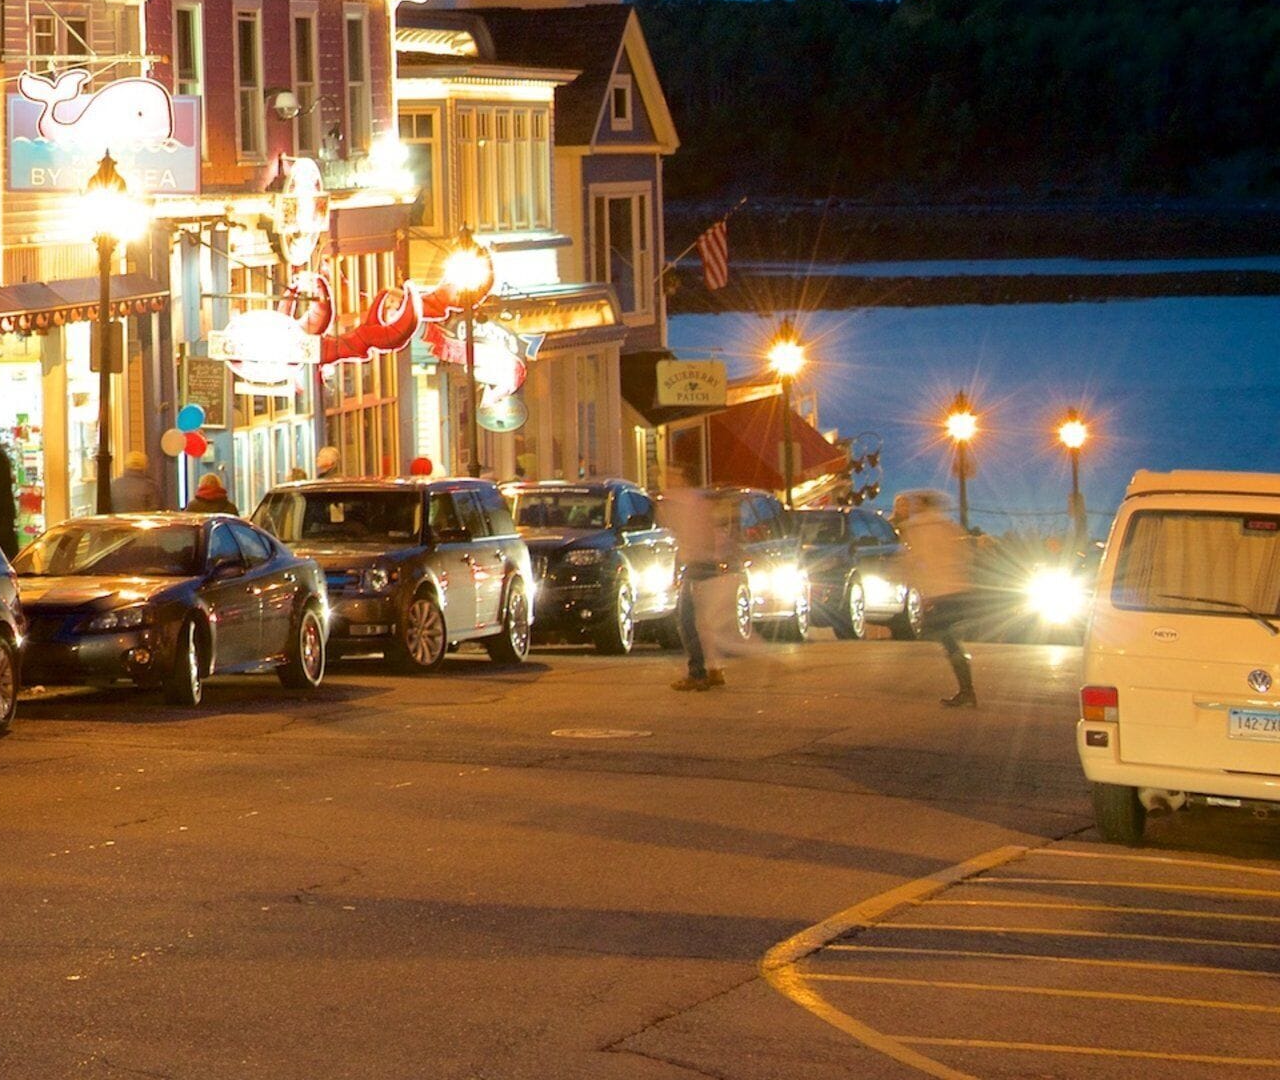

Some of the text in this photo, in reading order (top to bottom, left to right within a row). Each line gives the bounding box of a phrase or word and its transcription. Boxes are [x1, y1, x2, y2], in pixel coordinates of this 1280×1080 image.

[31, 168, 63, 186] BY
[677, 392, 710, 401] PATCH
[1238, 716, 1280, 732] 142-ZX
